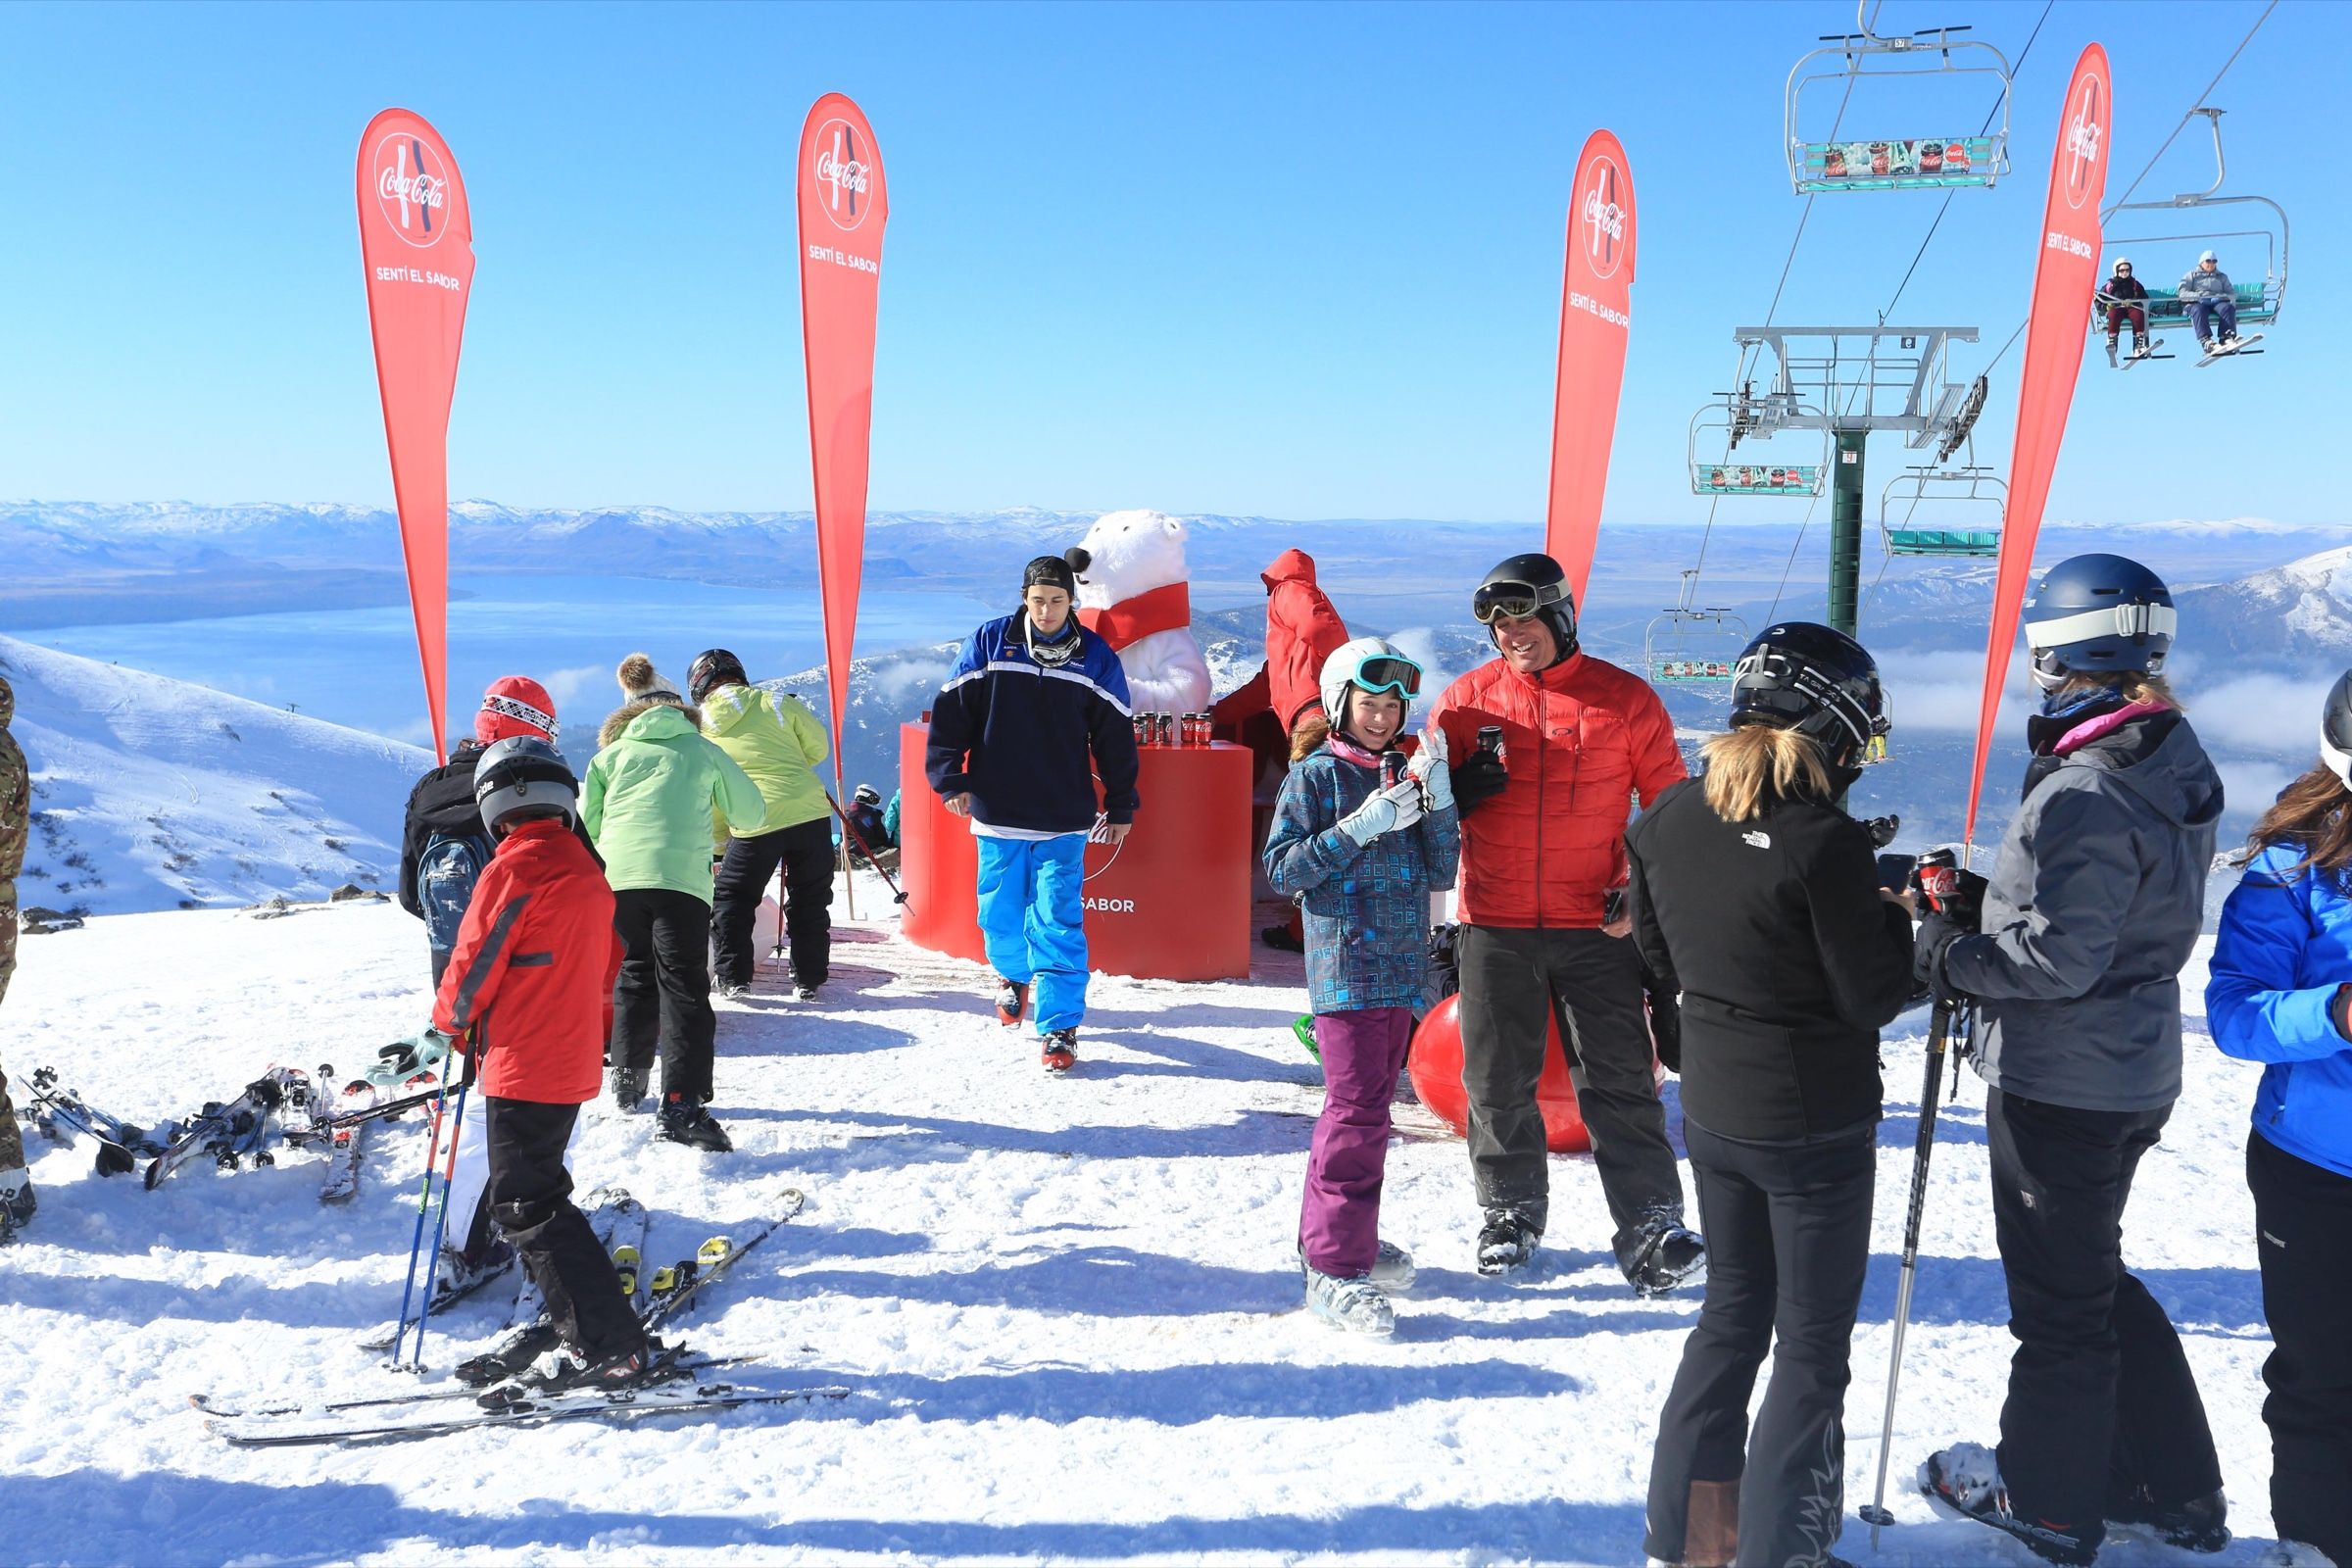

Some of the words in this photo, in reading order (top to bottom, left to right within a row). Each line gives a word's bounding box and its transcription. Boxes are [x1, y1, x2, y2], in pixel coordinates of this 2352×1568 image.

[379, 167, 447, 209] Coca-Cola
[816, 151, 870, 194] Coca-Cola
[1585, 189, 1626, 241] Coca-Cola
[808, 245, 833, 264] SENTÍ
[836, 251, 847, 266] EL
[848, 255, 878, 274] SABOR
[2063, 236, 2069, 251] EL
[2070, 237, 2091, 259] SABOR
[376, 266, 408, 280] SENTÍ
[410, 270, 424, 283] EL
[1570, 291, 1590, 310] SENTÍ
[1590, 300, 1598, 315] EL
[1599, 304, 1629, 329] SABOR
